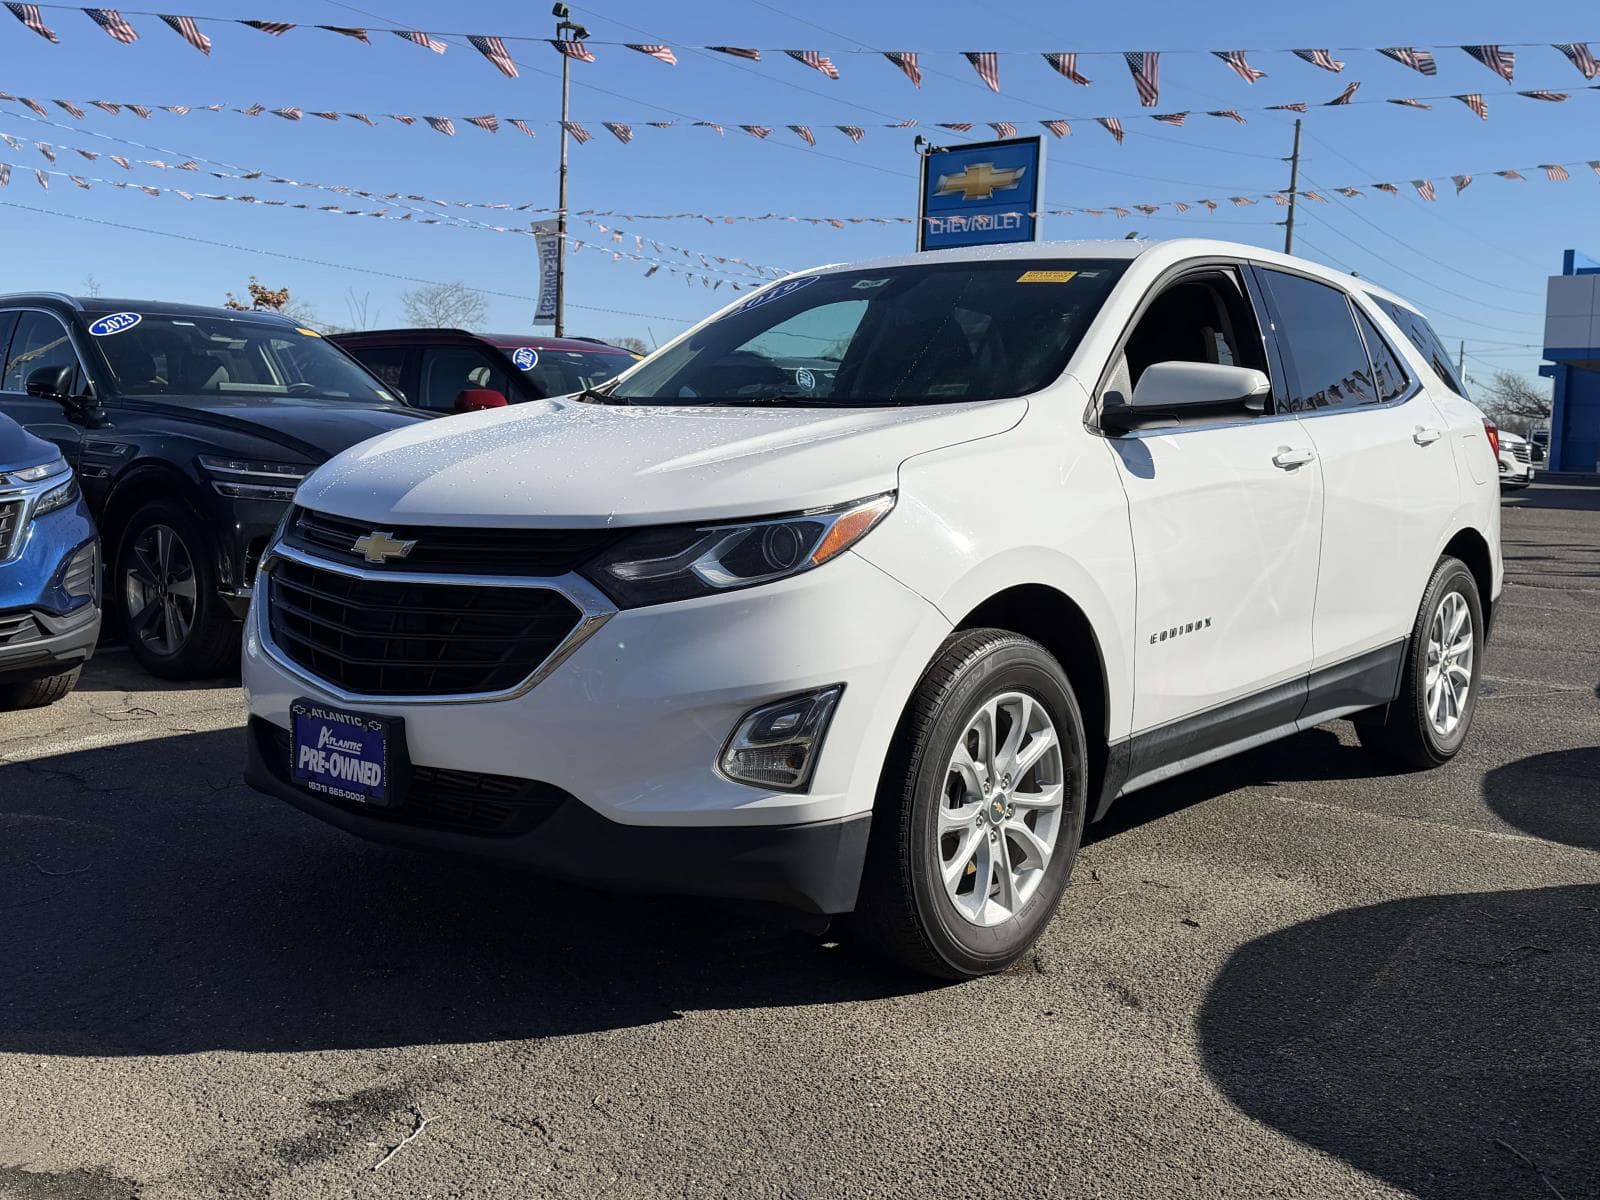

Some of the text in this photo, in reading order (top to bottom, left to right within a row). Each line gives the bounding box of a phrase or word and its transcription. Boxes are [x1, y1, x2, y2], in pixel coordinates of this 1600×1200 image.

[930, 214, 1021, 235] CHEVROLET
[540, 240, 558, 312] PRE-OWNED
[99, 314, 134, 333] 2023
[1149, 617, 1212, 645] EQUINOX
[311, 708, 363, 728] ATLANTIC
[299, 745, 382, 787] PRE-OWNED
